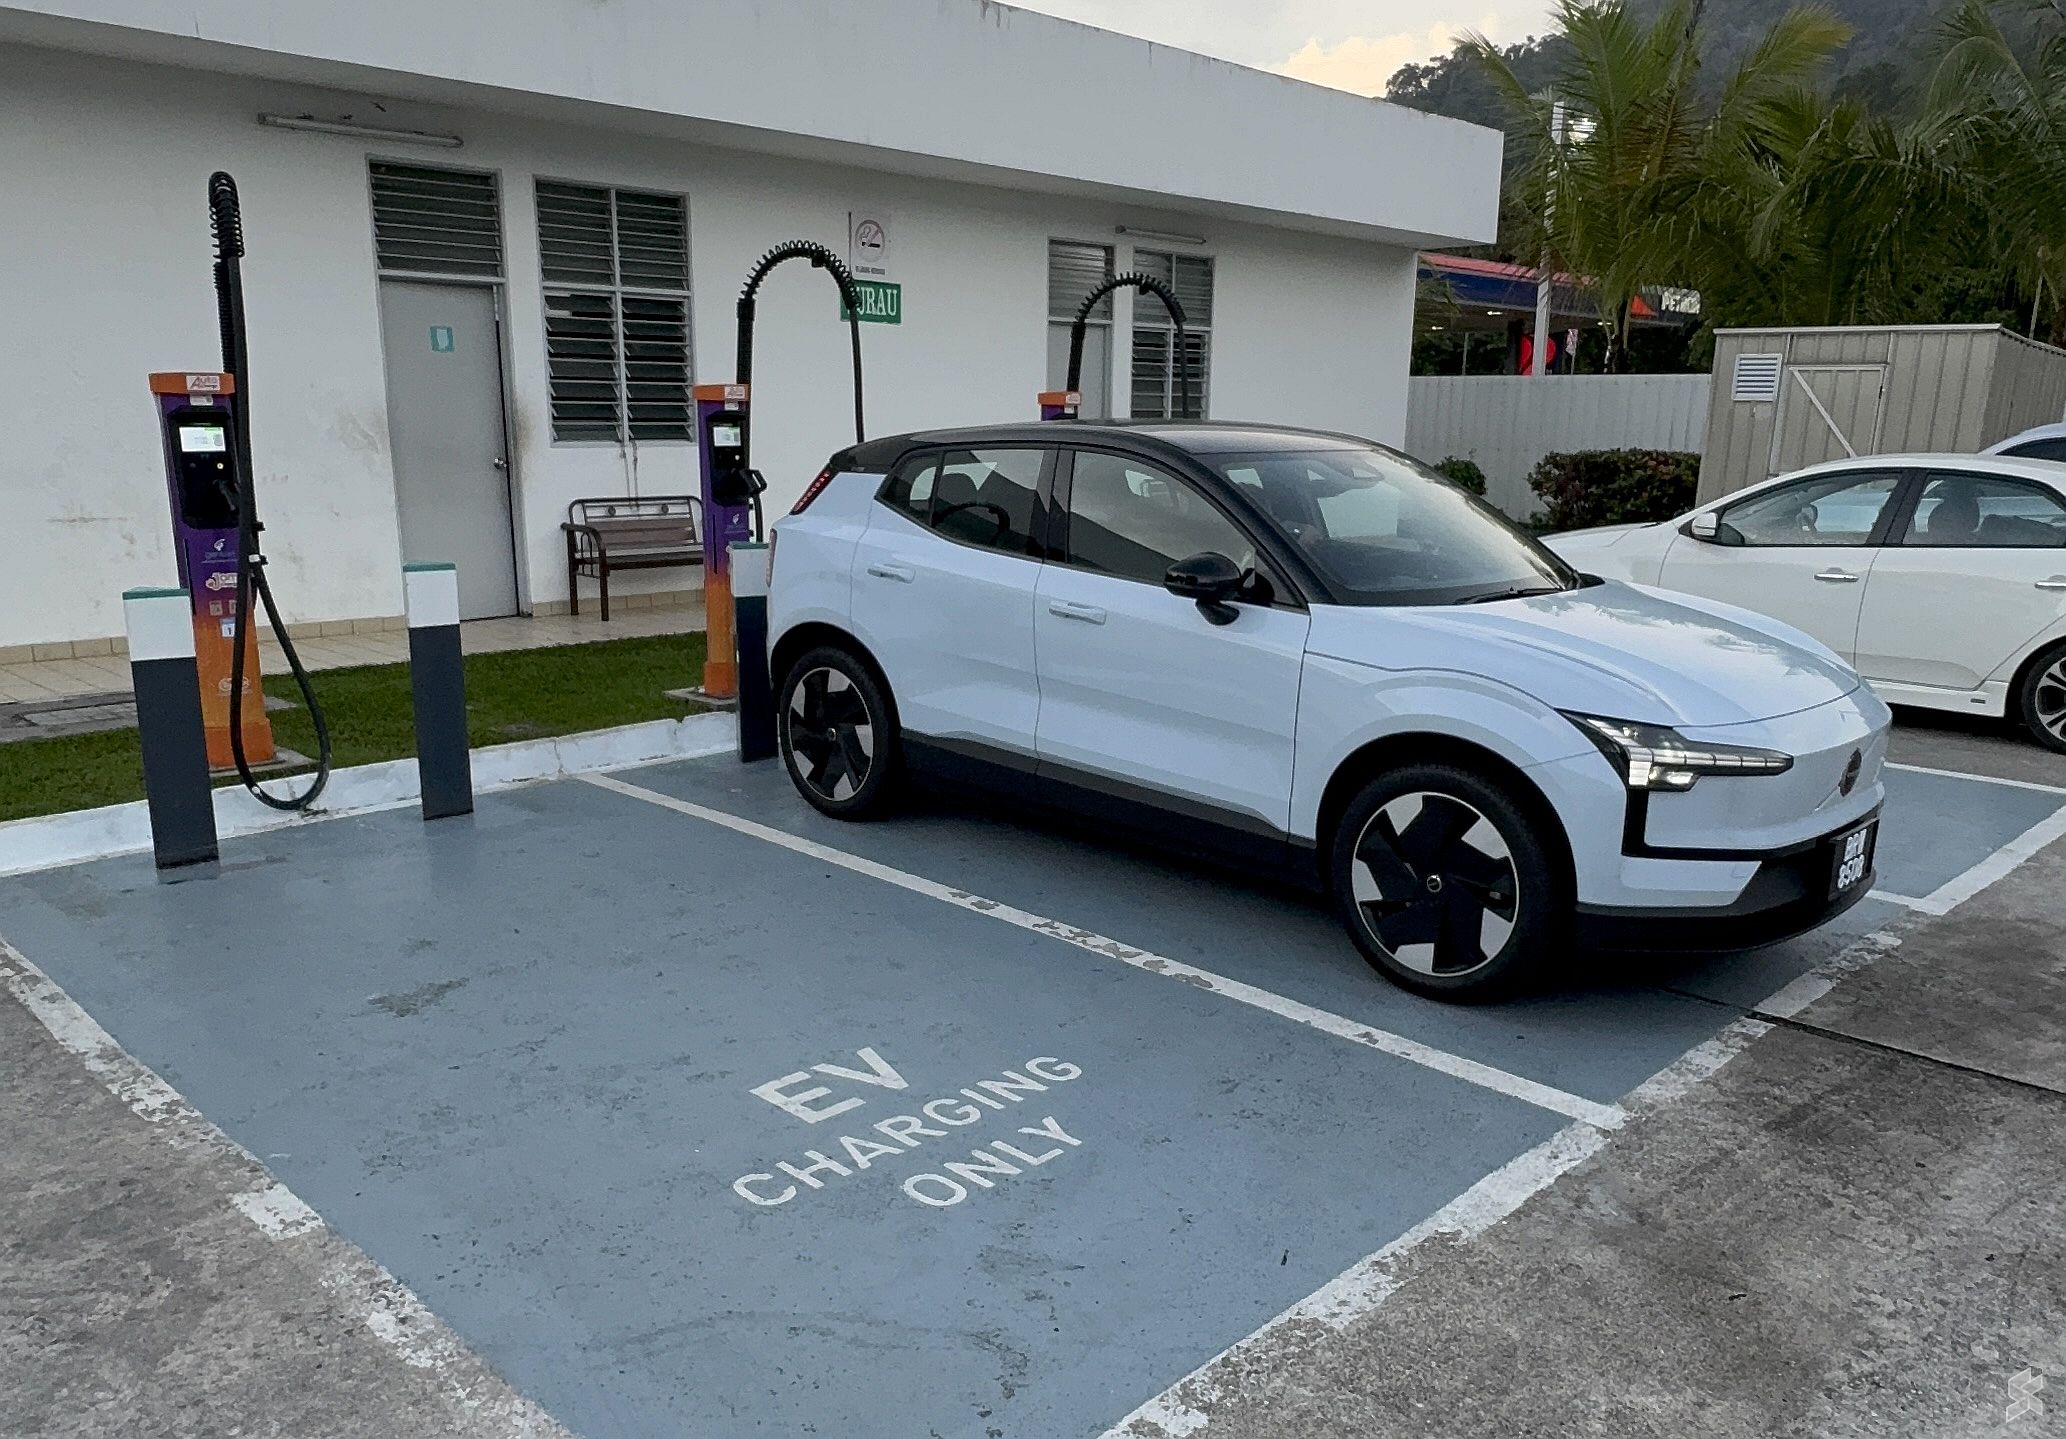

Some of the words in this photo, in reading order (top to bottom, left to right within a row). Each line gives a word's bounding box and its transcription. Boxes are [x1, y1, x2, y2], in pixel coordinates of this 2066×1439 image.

[847, 285, 897, 316] URAU
[749, 1047, 909, 1124] EV
[733, 1056, 1083, 1206] CHARGING
[903, 1116, 1083, 1207] ONLY
